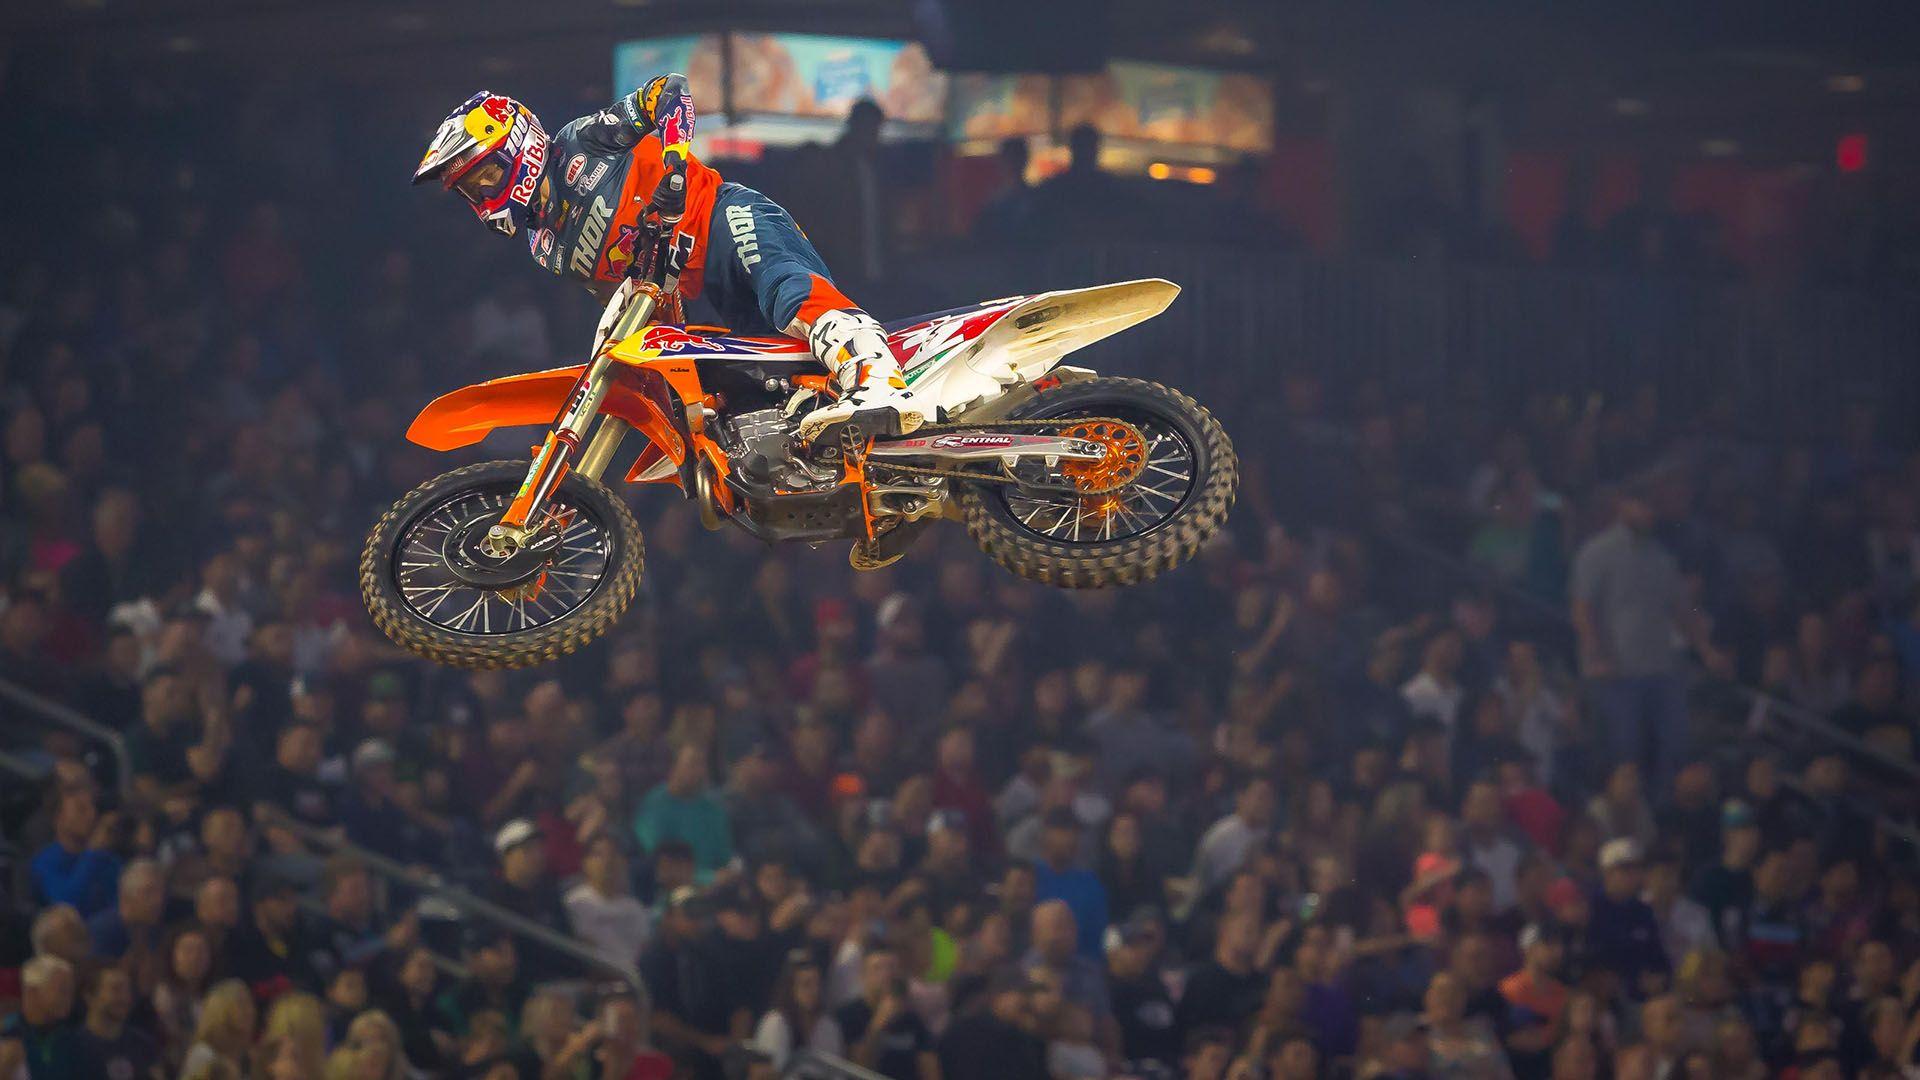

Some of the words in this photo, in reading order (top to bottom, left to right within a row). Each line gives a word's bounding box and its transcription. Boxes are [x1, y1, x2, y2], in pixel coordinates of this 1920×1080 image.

[503, 113, 529, 157] 100
[510, 159, 541, 206] Red
[526, 122, 547, 164] Bull
[567, 159, 584, 182] BELL
[570, 194, 614, 278] THOR
[725, 204, 762, 274] THOR
